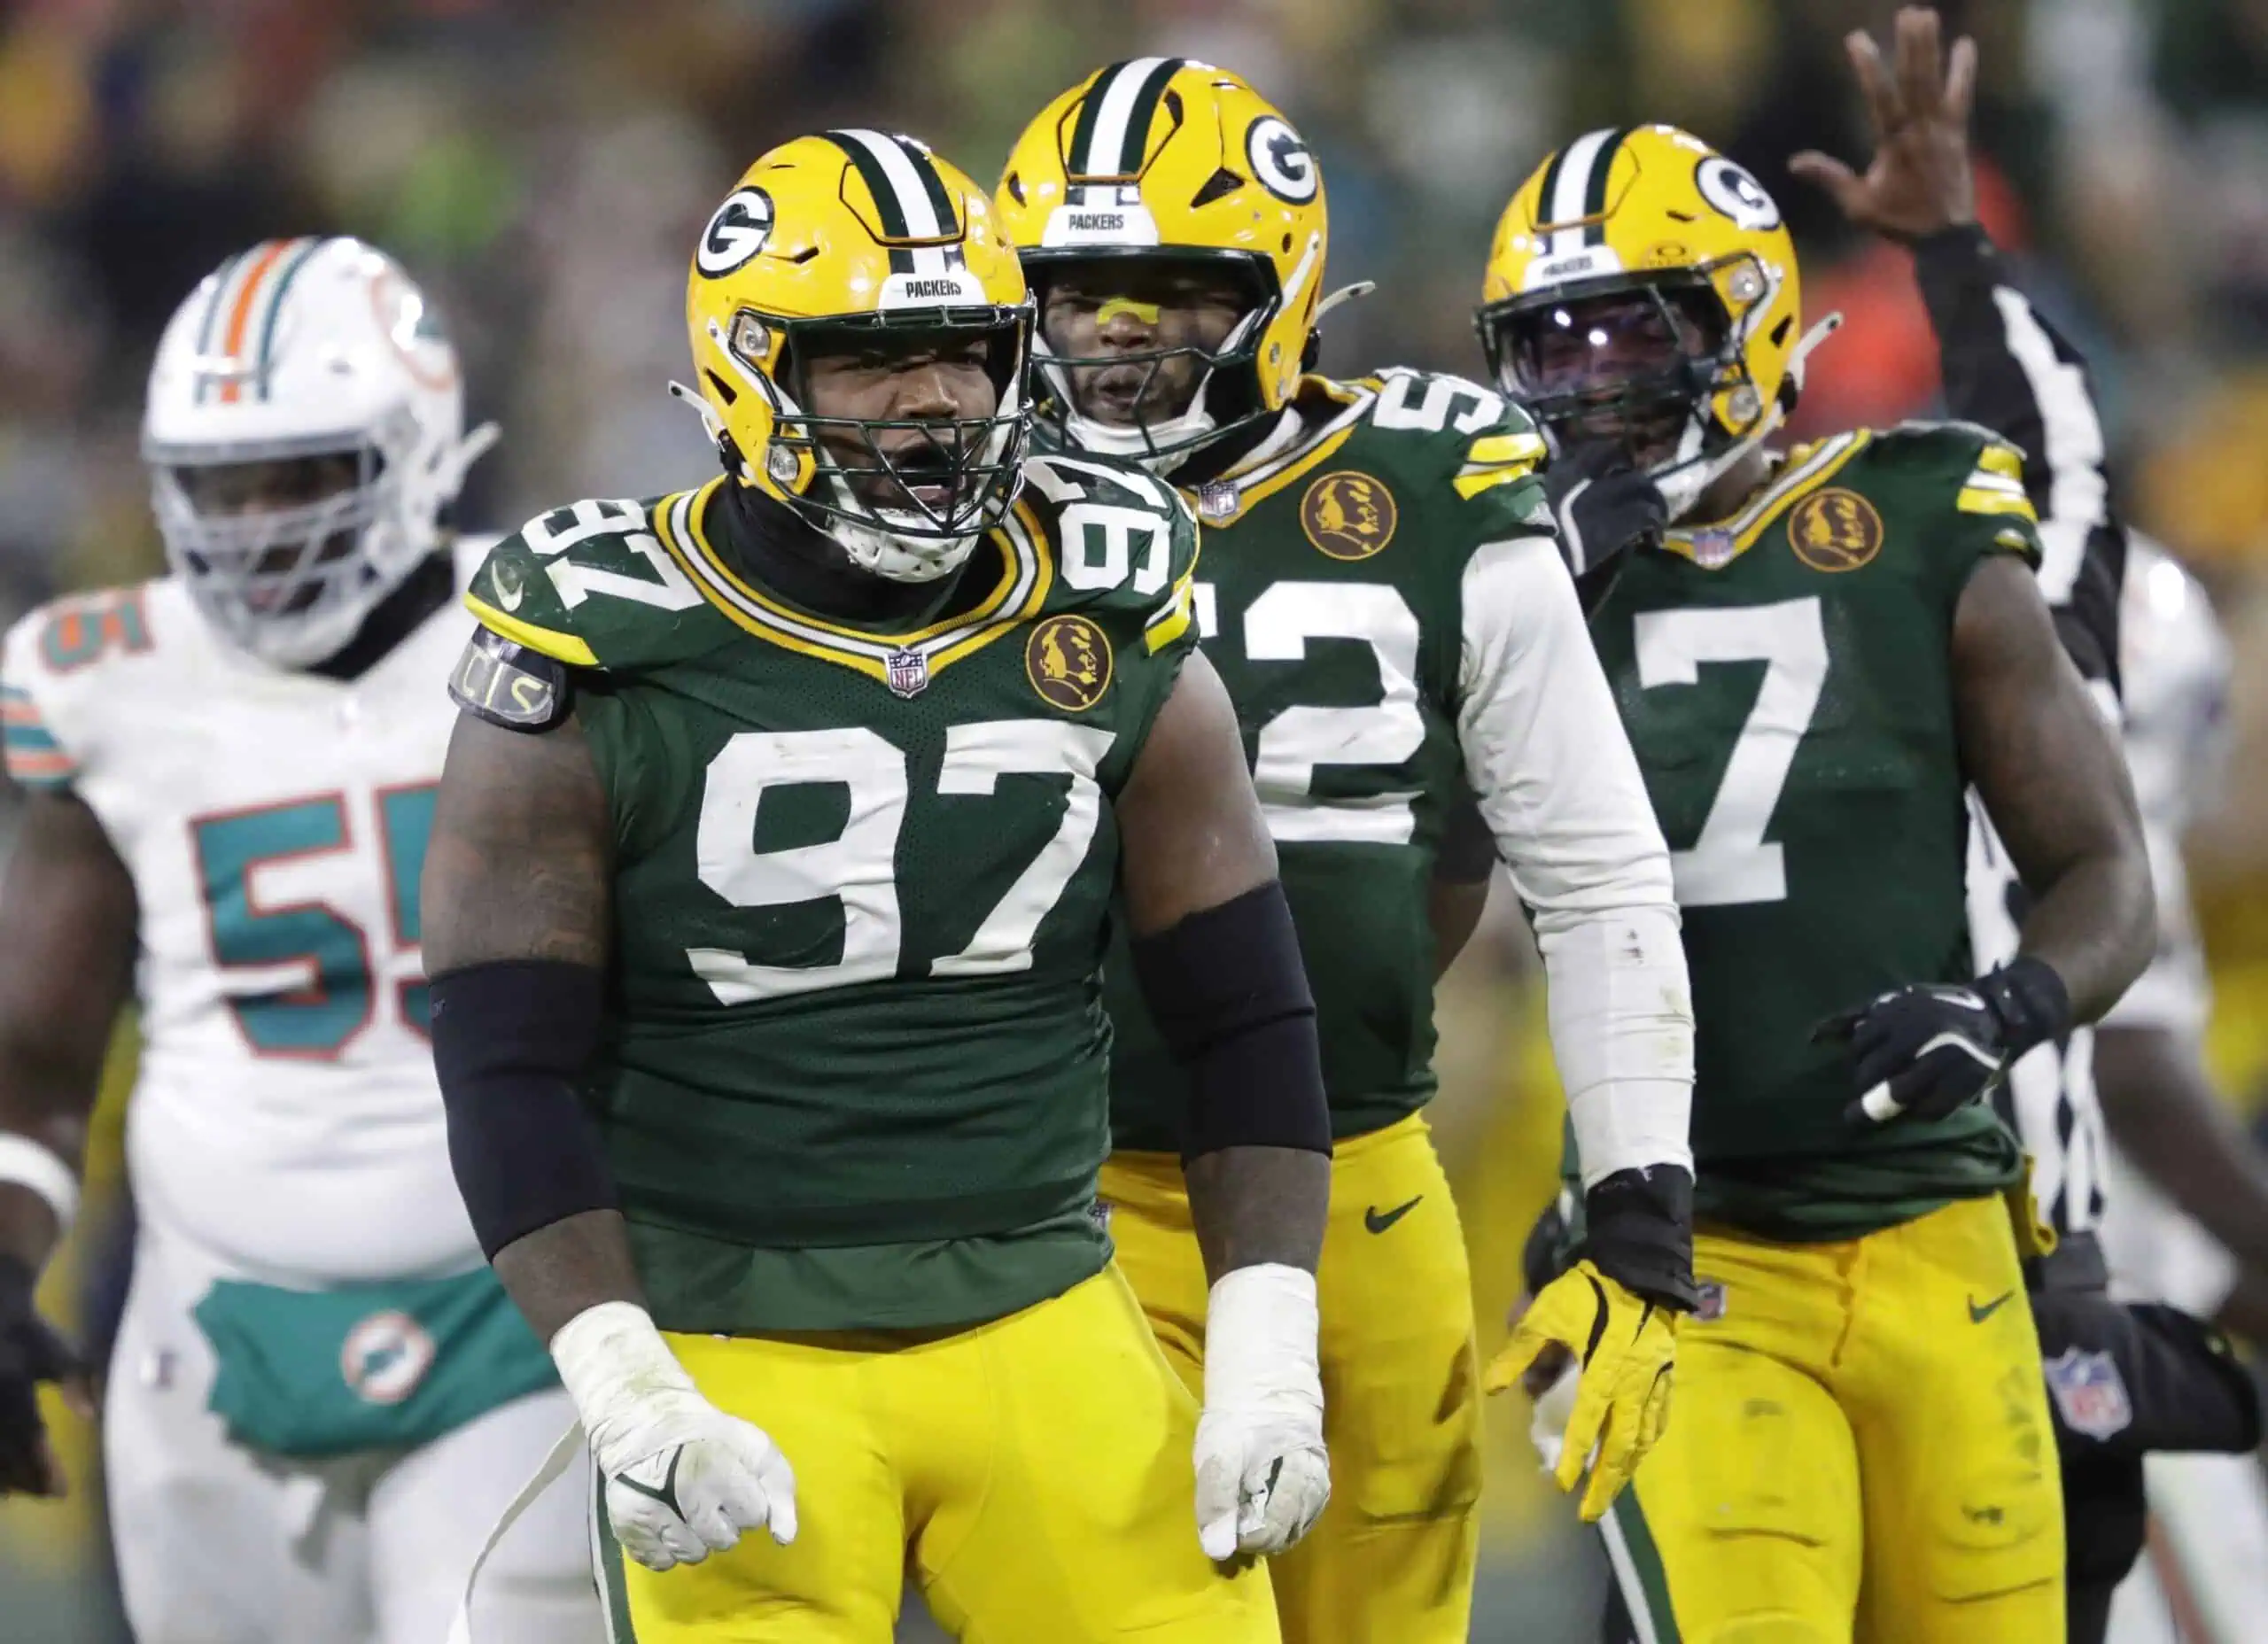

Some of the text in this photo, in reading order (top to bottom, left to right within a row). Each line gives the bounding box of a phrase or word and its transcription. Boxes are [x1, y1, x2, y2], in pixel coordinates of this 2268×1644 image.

[1068, 213, 1124, 230] PACKERS
[905, 280, 962, 299] PACKERS
[1372, 365, 1504, 435] 5
[521, 499, 706, 611] 97
[891, 666, 924, 690] NFL
[1192, 580, 1426, 845] 2
[1633, 595, 1829, 907] 7
[685, 718, 1117, 1006] 97
